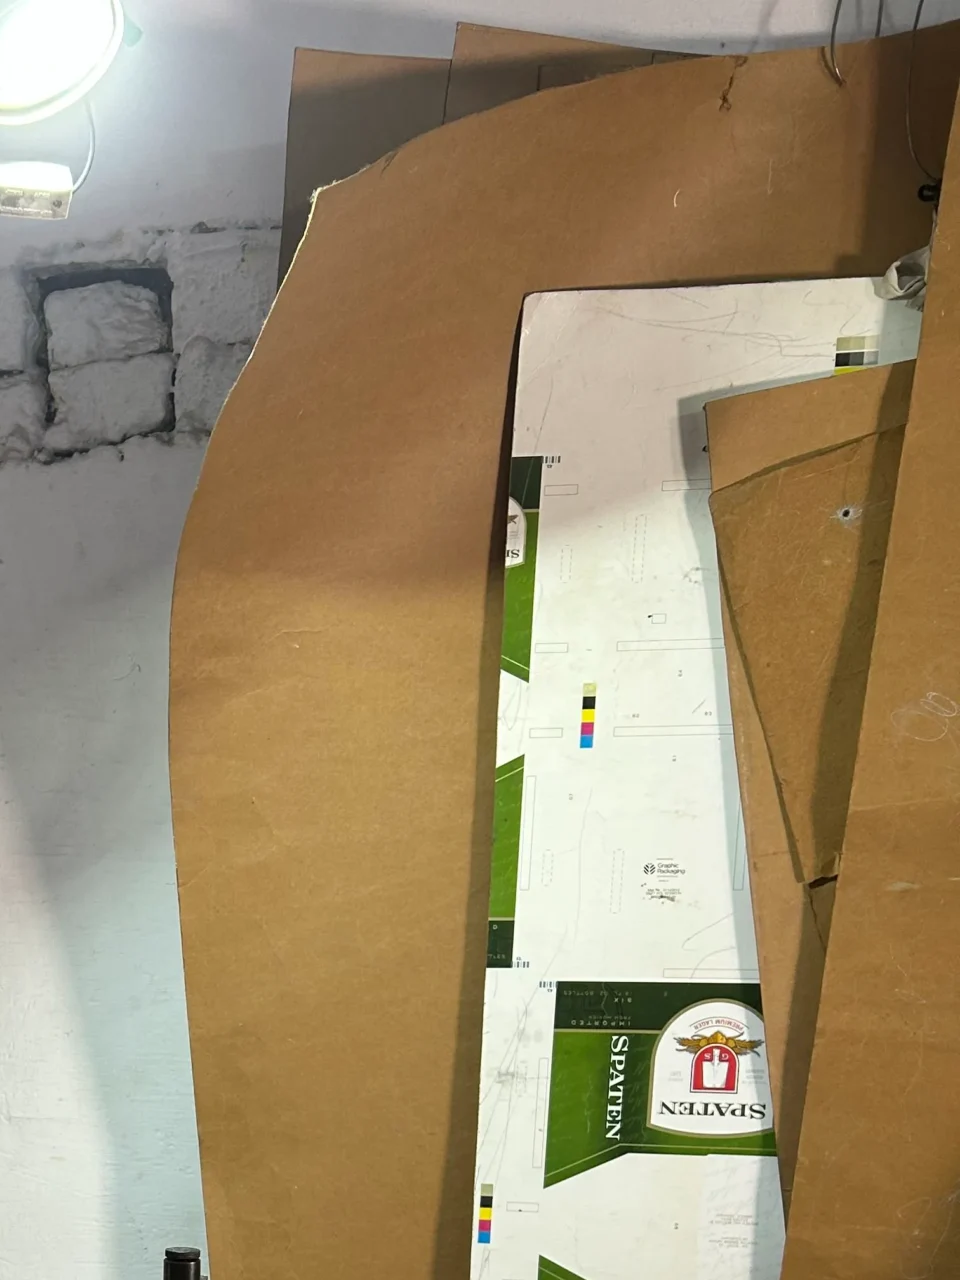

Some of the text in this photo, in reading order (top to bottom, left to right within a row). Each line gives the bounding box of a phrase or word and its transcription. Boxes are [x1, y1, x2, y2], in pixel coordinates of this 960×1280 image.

[570, 1019, 632, 1027] IMPORTED
[693, 1018, 744, 1032] PREMIUM LAGER
[605, 1034, 629, 1141] SPATEN
[658, 1100, 767, 1120] SPATEN
